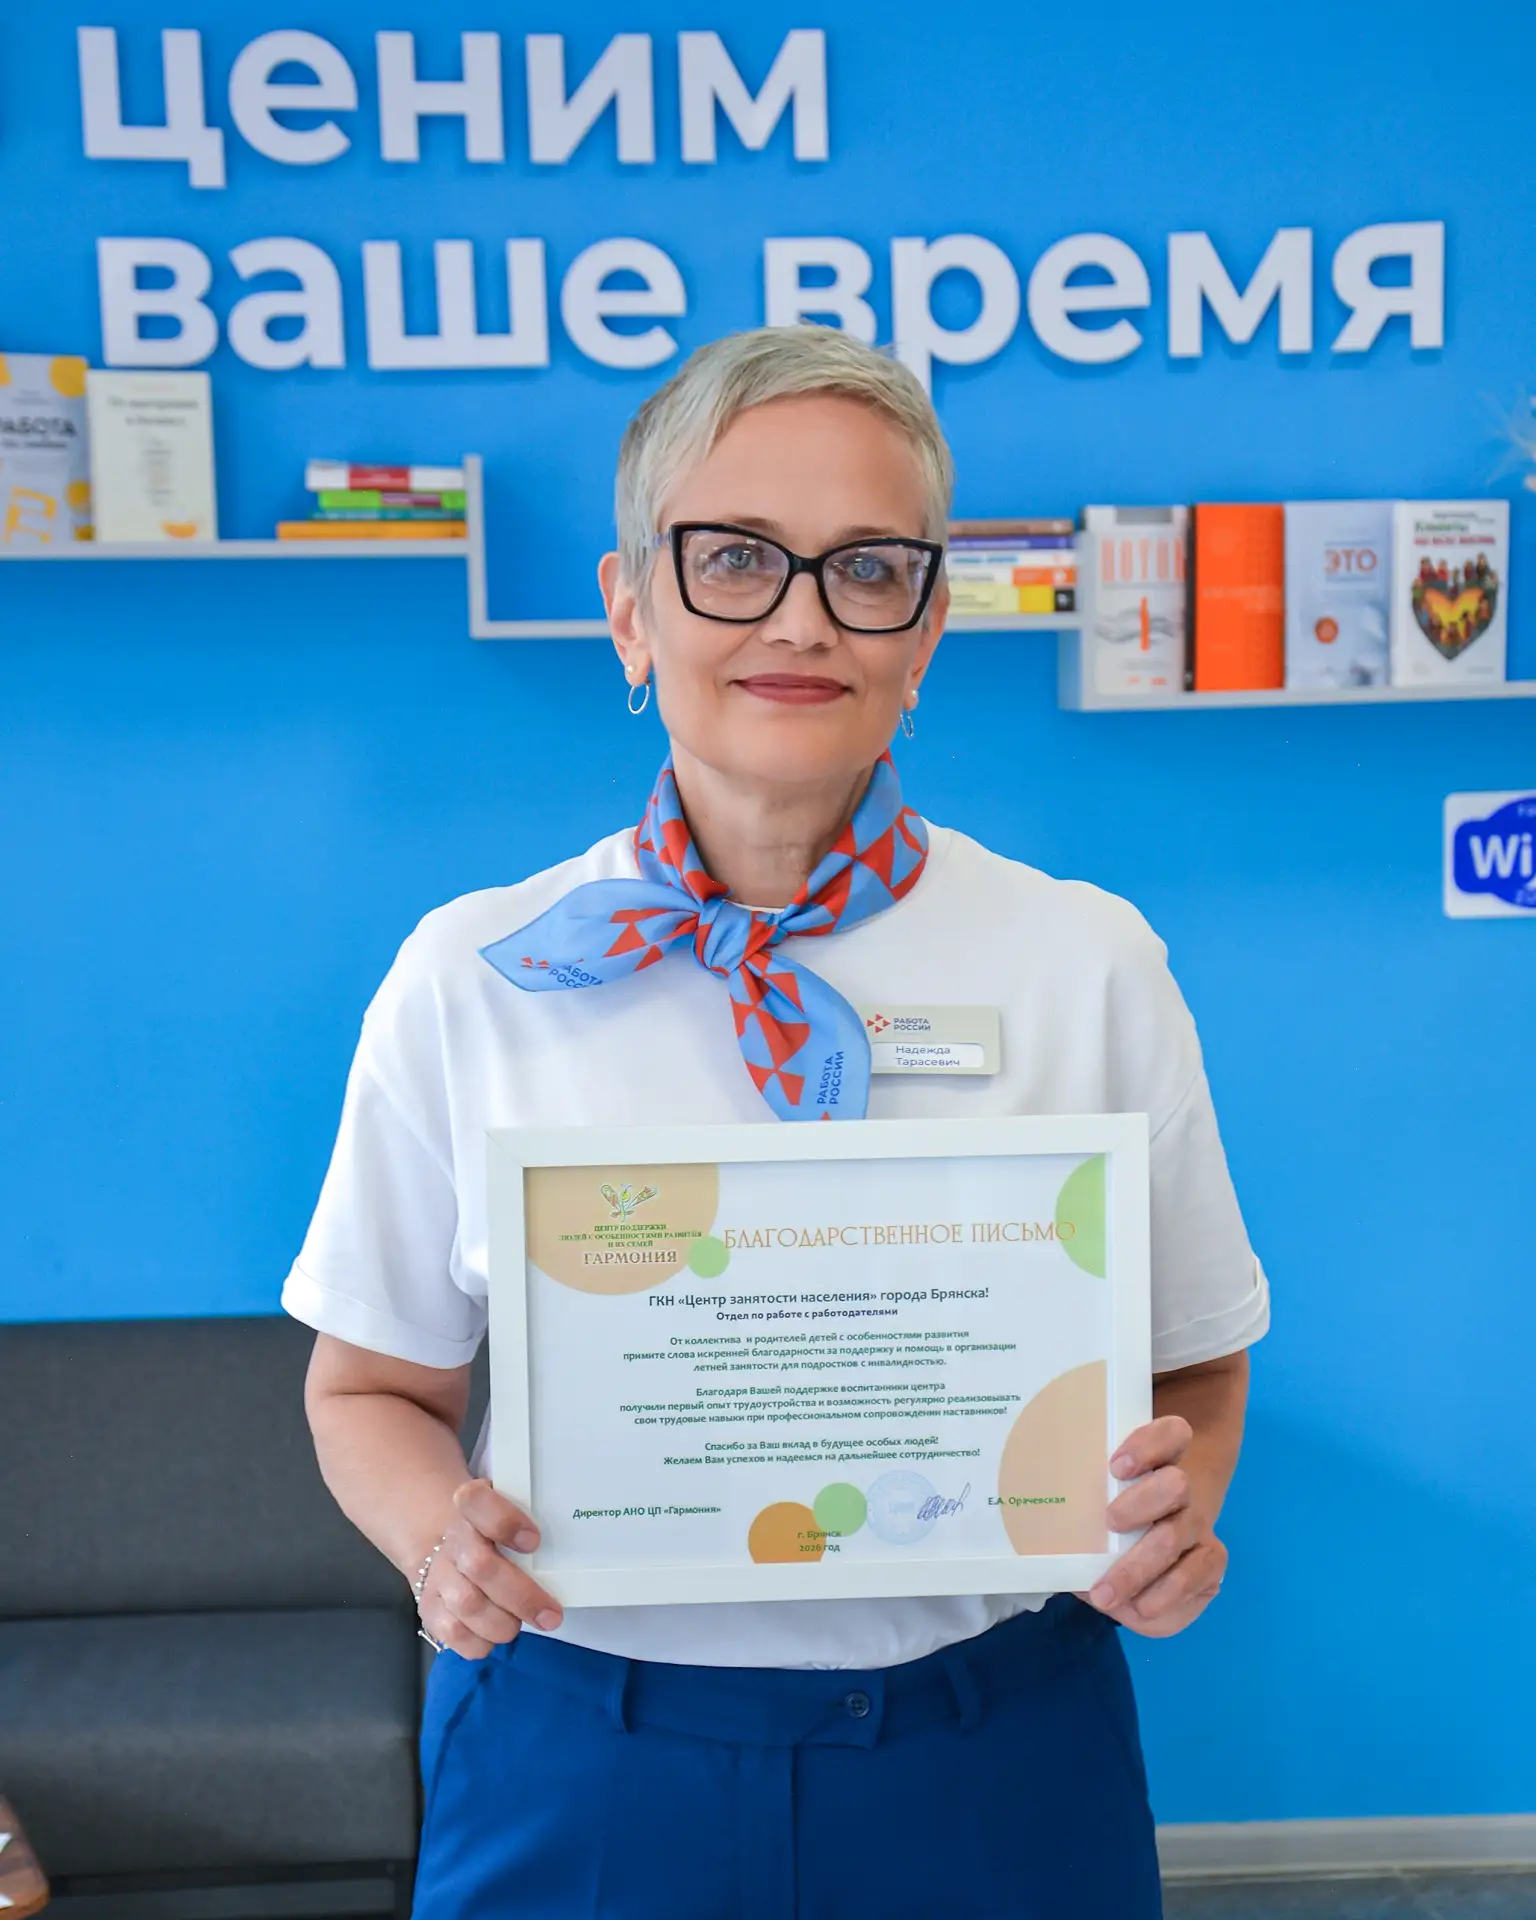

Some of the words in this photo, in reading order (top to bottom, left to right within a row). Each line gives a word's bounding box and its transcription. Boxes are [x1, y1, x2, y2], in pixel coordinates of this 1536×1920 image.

[76, 26, 830, 189] ценим
[97, 236, 687, 370] ваше
[764, 221, 1446, 398] время
[893, 1017, 929, 1025] РАБОТА
[893, 1024, 931, 1032] РОССИИ
[895, 1045, 951, 1056] Надежда
[896, 1057, 961, 1067] Тарасевич
[817, 1056, 834, 1105] РАБОТА
[829, 1051, 845, 1105] РОССИИ
[724, 1224, 963, 1249] БЛАГОДАРСТВЕННОЕ
[971, 1221, 1075, 1243] ПИСЬМО
[584, 1250, 678, 1265] ГАРМОНИЯ
[650, 1294, 674, 1306] ГКН
[679, 1293, 726, 1307] «Центр
[730, 1294, 796, 1304] занятости
[801, 1292, 876, 1302] населения»
[881, 1290, 926, 1302] города
[931, 1286, 988, 1301] Брянска!
[717, 1311, 748, 1321] Отдел
[767, 1309, 802, 1320] работе
[812, 1308, 897, 1319] работодателями
[670, 1336, 683, 1345] От
[685, 1336, 741, 1345] коллектива
[755, 1332, 806, 1345] родителей
[809, 1332, 837, 1343] детей
[847, 1331, 922, 1341] особенностями
[925, 1330, 969, 1340] развития
[624, 1352, 665, 1361] примите
[668, 1351, 695, 1359] слова
[697, 1347, 749, 1359] искренней
[752, 1347, 825, 1357] благодарности
[840, 1346, 893, 1355] поддержку
[897, 1345, 902, 1353] и
[905, 1344, 944, 1353] помощь
[955, 1342, 1016, 1353] организации
[694, 1361, 727, 1371] летней
[730, 1362, 778, 1370] занятости
[781, 1361, 799, 1370] для
[801, 1360, 858, 1370] подростков
[868, 1357, 946, 1367] инвалидностью.
[697, 1387, 748, 1397] Благодаря
[750, 1385, 781, 1395] Вашей
[784, 1385, 838, 1395] поддержке
[841, 1383, 908, 1392] воспитанники
[911, 1382, 945, 1391] центра
[620, 1403, 665, 1413] получили
[668, 1400, 704, 1411] первый
[707, 1401, 730, 1409] опыт
[733, 1398, 816, 1410] трудоустройства
[827, 1397, 891, 1406] возможность
[894, 1396, 945, 1406] регулярно
[948, 1394, 1020, 1404] реализовывать
[635, 1416, 656, 1424] свои
[659, 1415, 706, 1425] трудовые
[709, 1414, 744, 1422] навыки
[747, 1414, 764, 1423] при
[767, 1411, 861, 1422] профессиональном
[863, 1409, 941, 1419] сопровождении
[943, 1405, 1007, 1416] наставников!
[705, 1441, 745, 1451] Спасибо
[760, 1440, 779, 1449] Ваш
[782, 1441, 811, 1449] вклад
[813, 1440, 818, 1448] в
[821, 1438, 863, 1449] будущее
[866, 1436, 901, 1446] особых
[904, 1435, 938, 1446] людей!
[664, 1456, 702, 1465] Желаем
[705, 1454, 725, 1464] Вам
[727, 1455, 765, 1465] успехов
[776, 1453, 822, 1462] надеемся
[838, 1450, 897, 1461] дальнейшее
[899, 1447, 980, 1459] сотрудничество!
[573, 1508, 621, 1518] Директор
[623, 1506, 645, 1516] АНО
[648, 1505, 661, 1516] ЦП
[664, 1505, 721, 1515] «Гармония»
[823, 1543, 841, 1552] год
